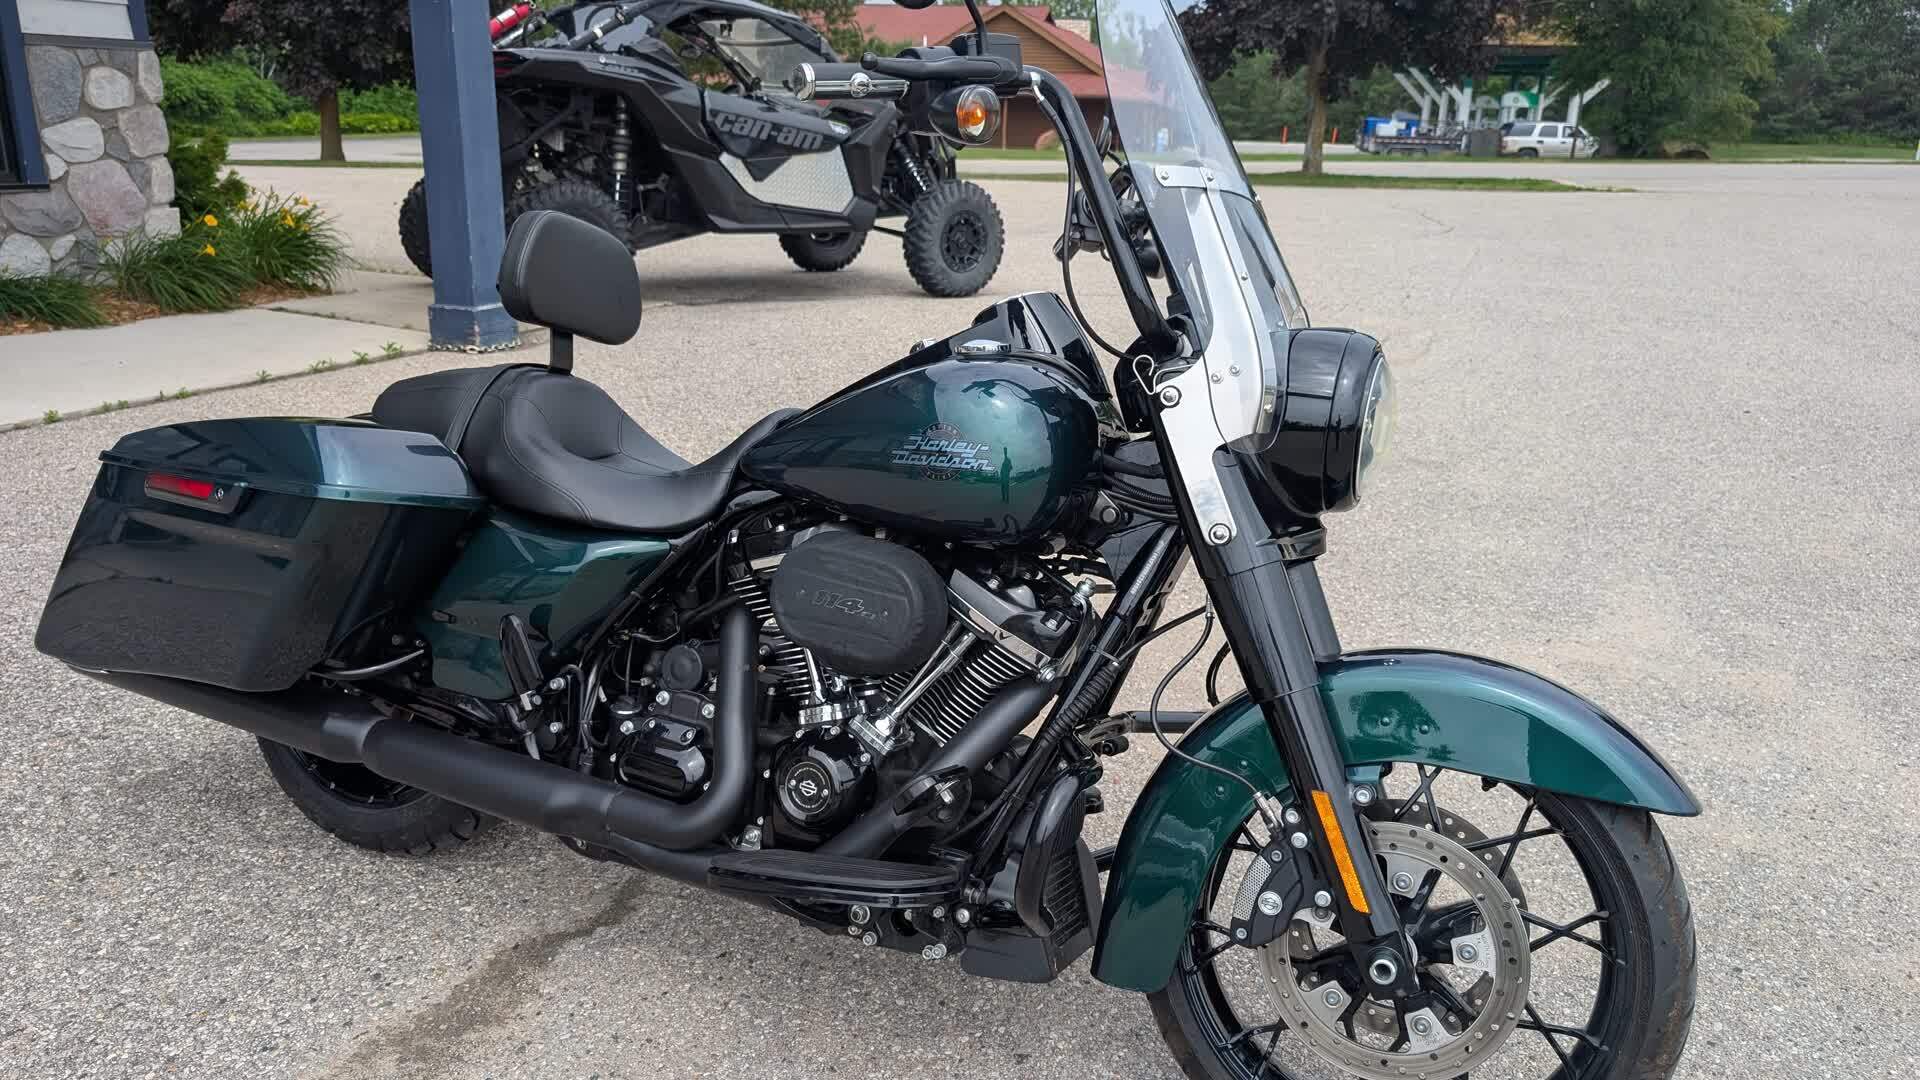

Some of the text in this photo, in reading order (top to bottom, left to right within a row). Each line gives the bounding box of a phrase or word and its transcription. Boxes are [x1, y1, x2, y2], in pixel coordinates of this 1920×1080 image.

[714, 111, 824, 150] can-am
[903, 434, 990, 457] Harley-
[891, 450, 995, 470] Davidson
